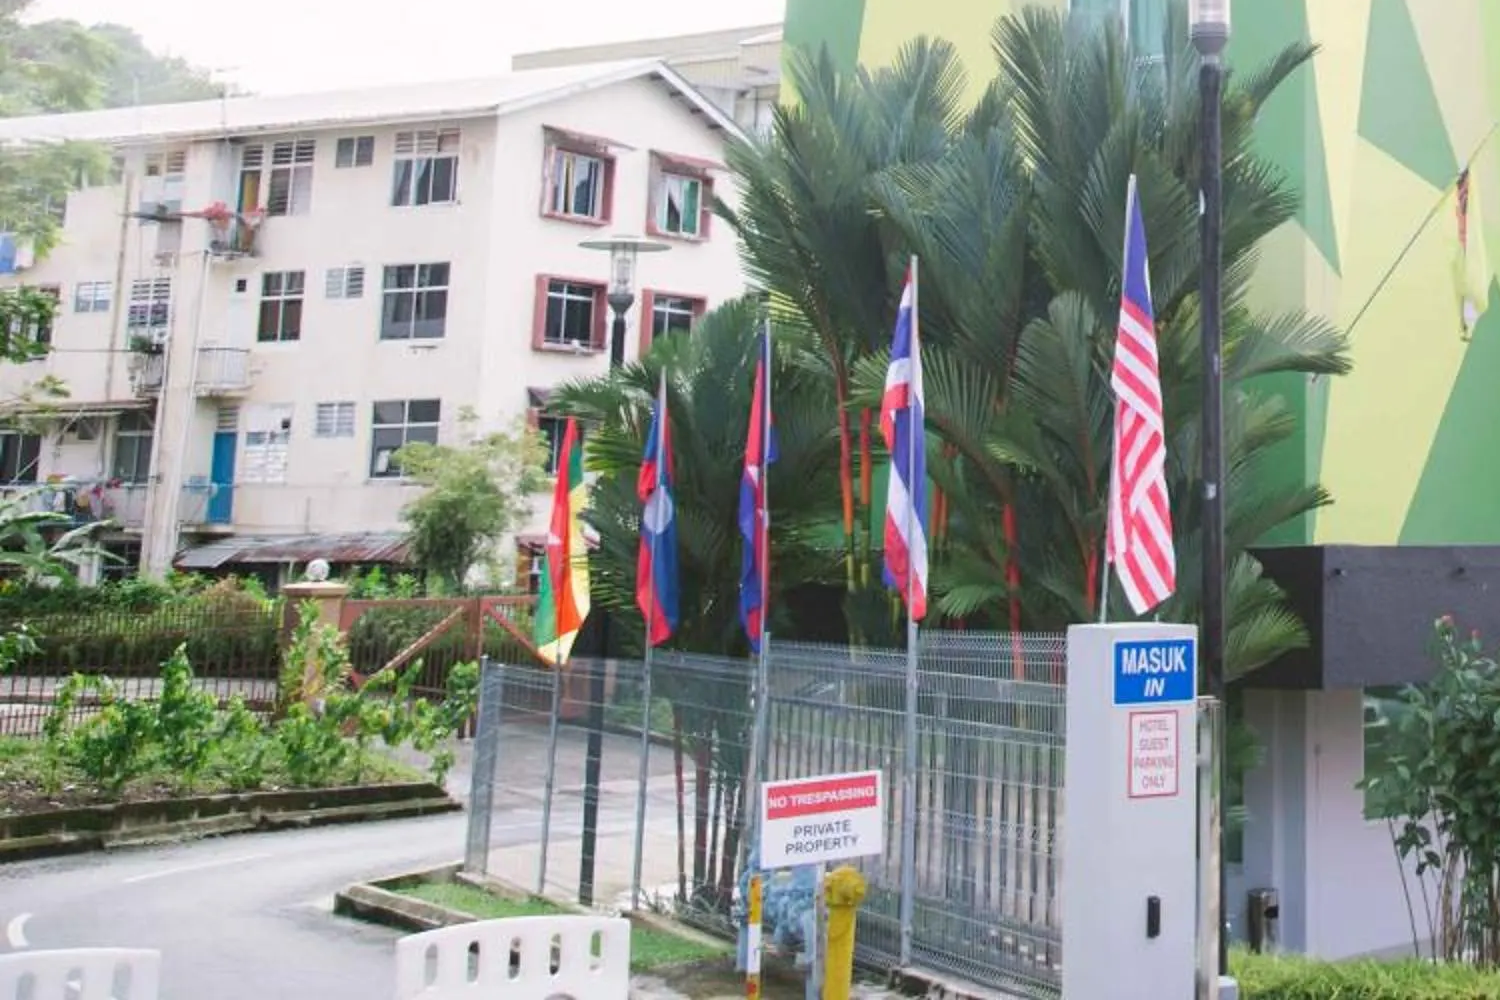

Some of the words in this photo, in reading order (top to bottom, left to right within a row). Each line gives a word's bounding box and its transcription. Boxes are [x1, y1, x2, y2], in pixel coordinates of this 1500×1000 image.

[1121, 646, 1187, 675] MASUK
[1143, 678, 1165, 697] IN
[1139, 719, 1169, 731] HOTEL
[1139, 737, 1169, 750] GUEST
[1133, 756, 1175, 769] PARKING
[1141, 775, 1165, 790] ONLY
[768, 795, 787, 809] NO
[791, 785, 874, 807] TRESPASSING
[793, 819, 852, 838] PRIVATE
[785, 835, 859, 855] PROPERTY
